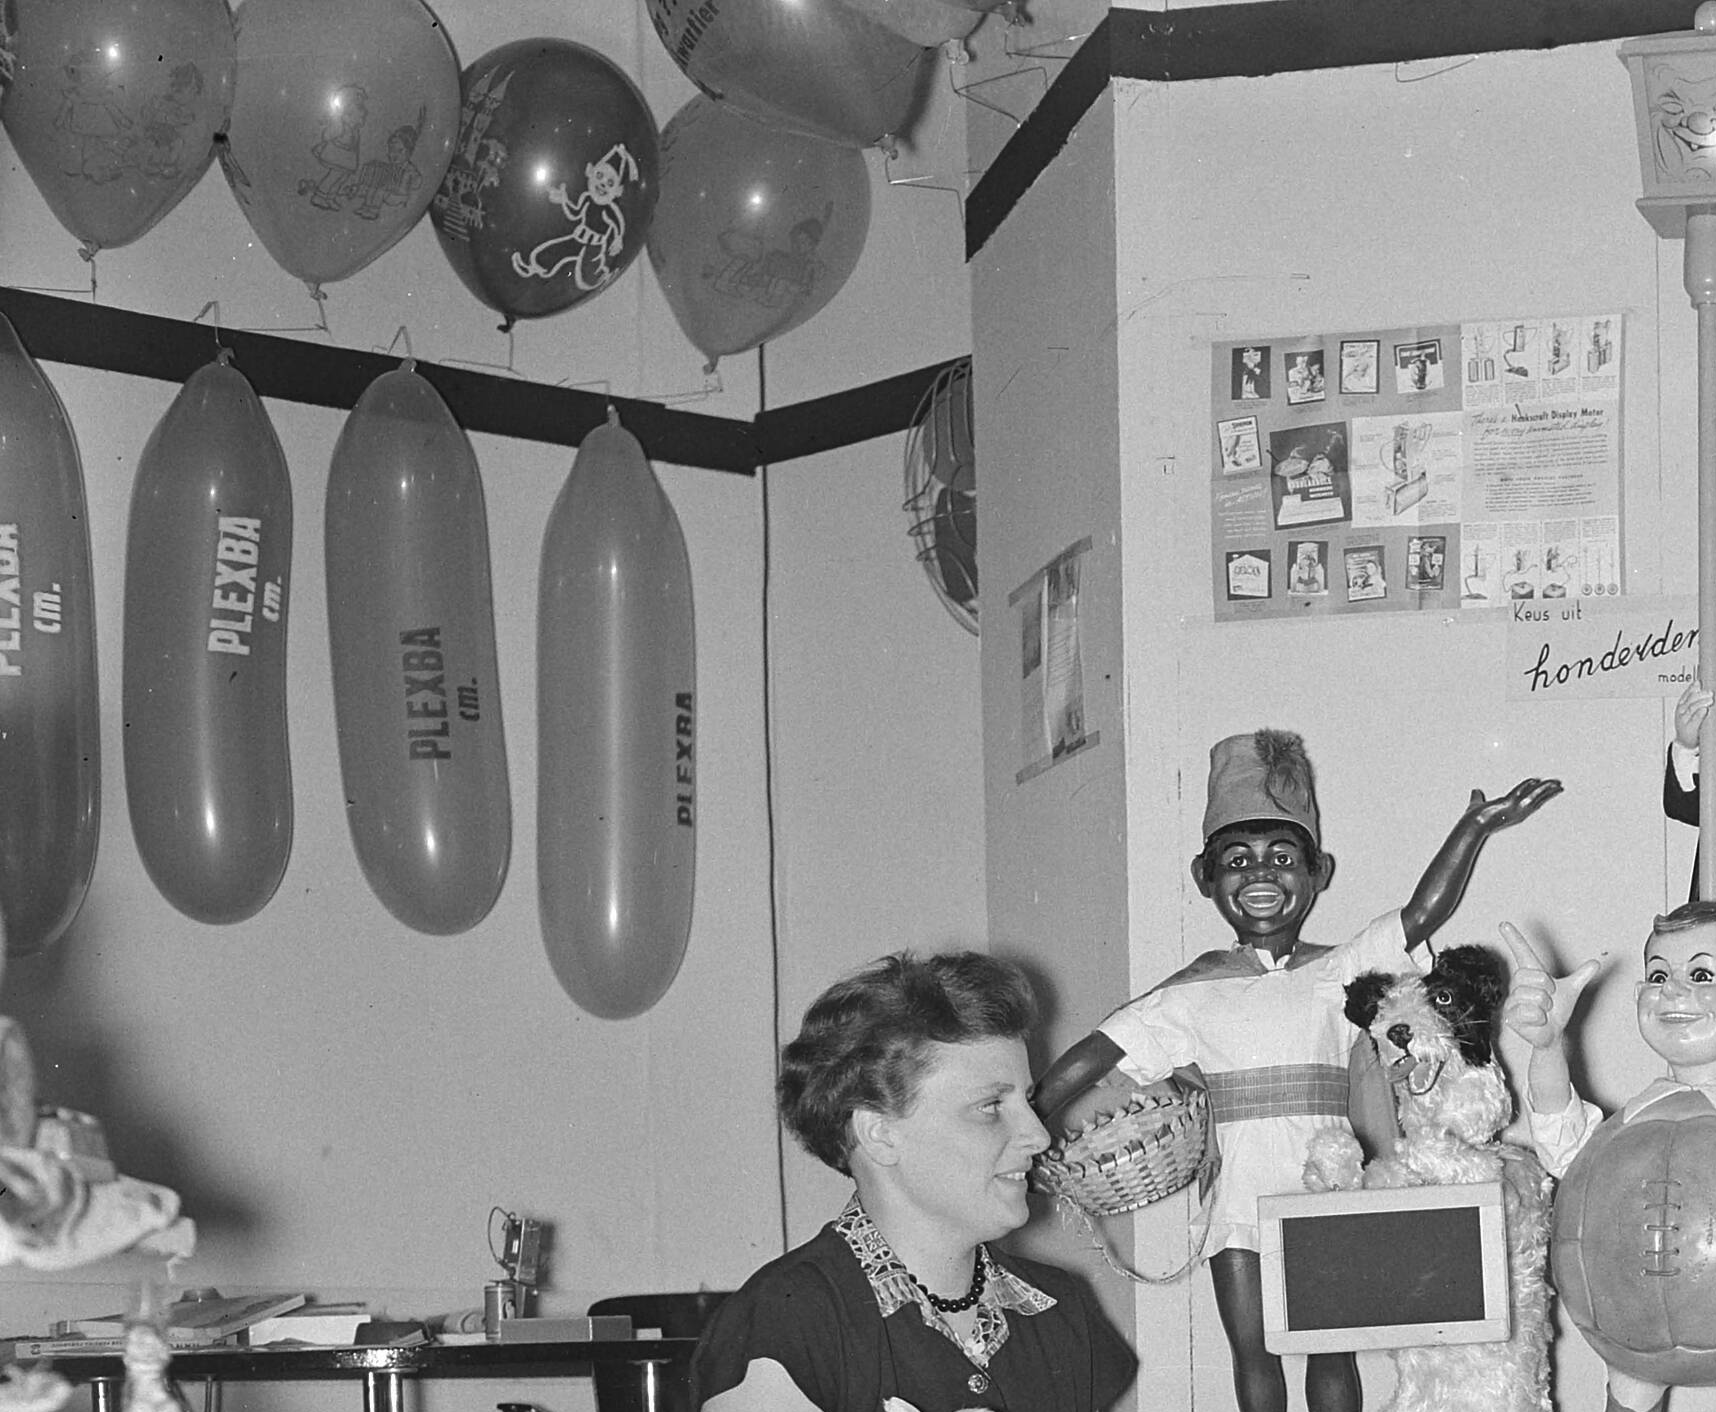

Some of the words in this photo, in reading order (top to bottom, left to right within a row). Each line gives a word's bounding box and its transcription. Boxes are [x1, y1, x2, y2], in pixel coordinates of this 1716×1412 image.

[1581, 408, 1604, 417] Motor
[207, 516, 261, 655] PLEXBA
[262, 575, 282, 622] cm.
[1514, 601, 1550, 622] Keus
[1562, 600, 1582, 621] uit
[400, 627, 451, 760] PLEXBA
[457, 677, 480, 721] cm.
